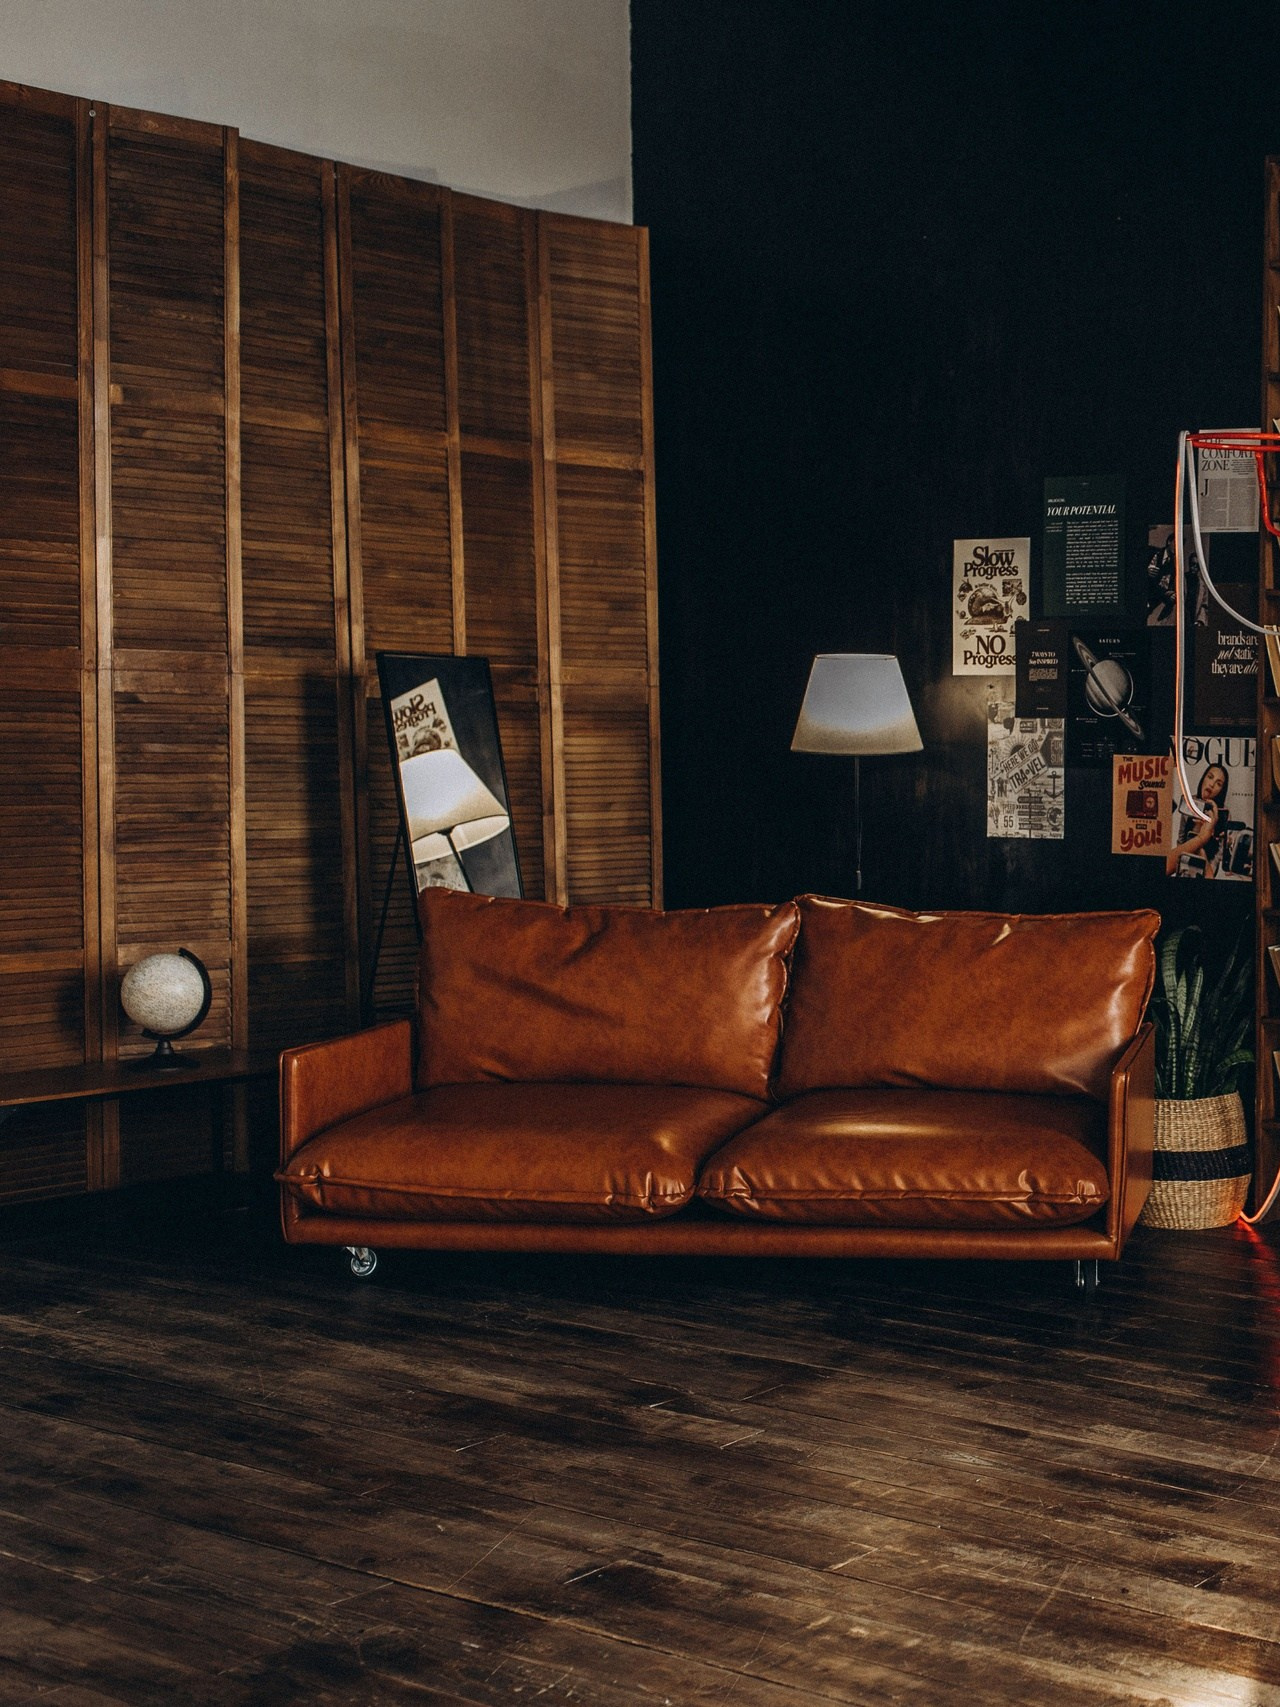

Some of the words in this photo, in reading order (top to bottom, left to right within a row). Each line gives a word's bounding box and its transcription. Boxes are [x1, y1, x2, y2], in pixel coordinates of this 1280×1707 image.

[1201, 460, 1230, 471] ZONE
[1047, 507, 1069, 516] YOUR
[1070, 504, 1116, 515] POTENTIAL
[972, 546, 1015, 567] Slow
[963, 562, 1019, 580] Progress
[976, 635, 1006, 655] NO
[1217, 630, 1245, 645] brands
[1211, 660, 1229, 678] they
[1229, 663, 1243, 674] are
[1003, 756, 1019, 773] HERE
[1019, 747, 1030, 760] WE
[1118, 757, 1169, 784] MUSIC
[1003, 816, 1014, 828] 55
